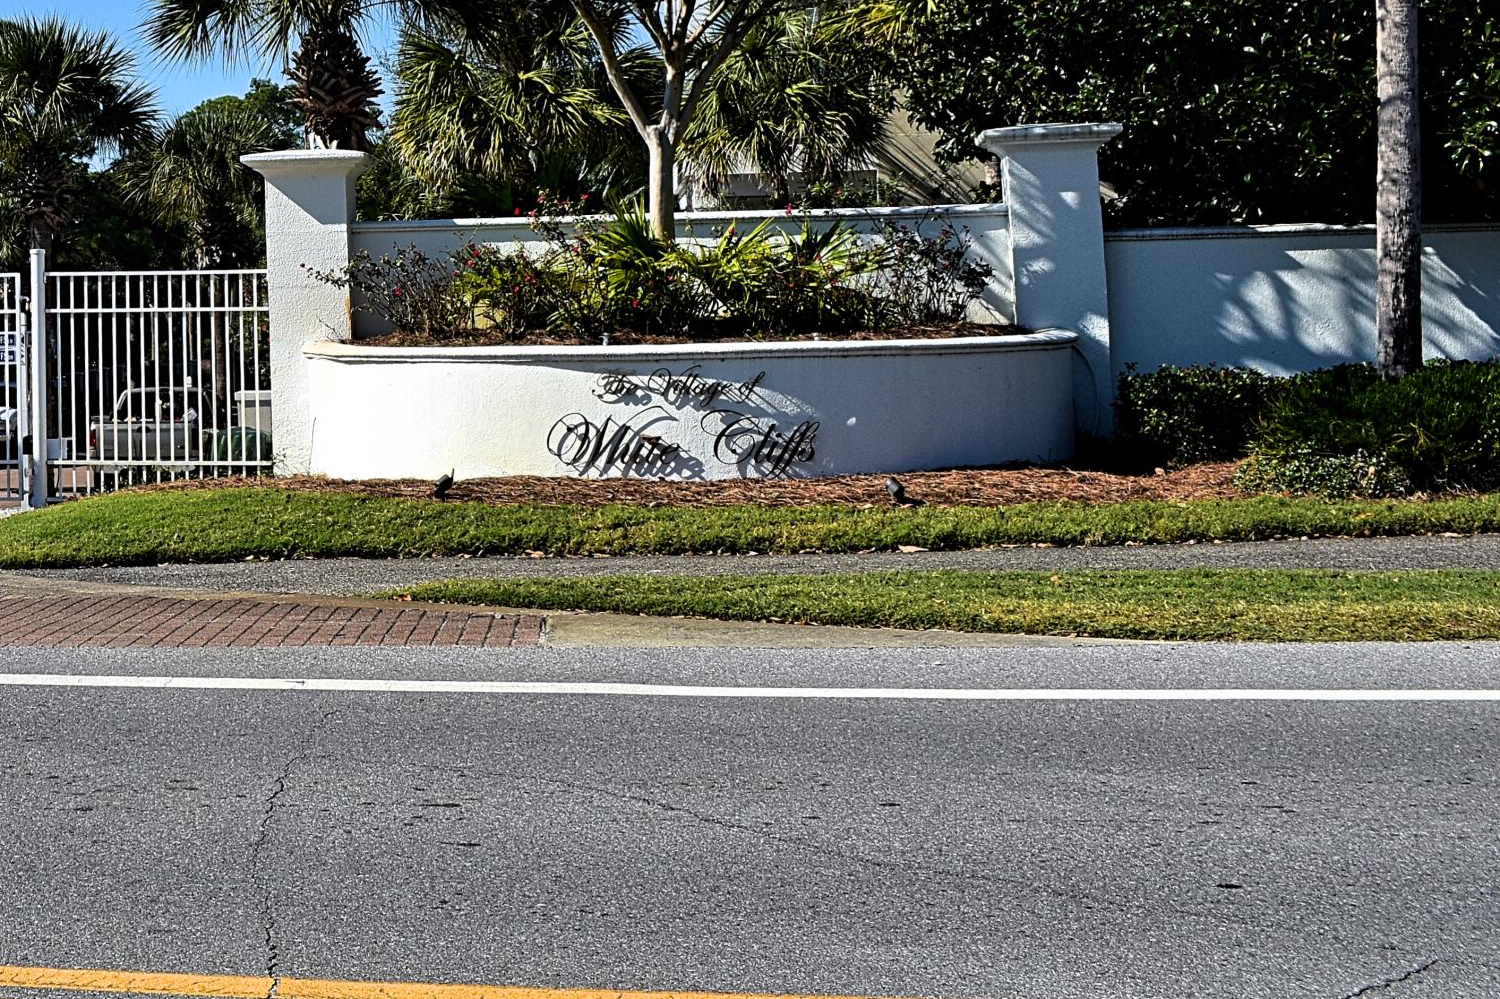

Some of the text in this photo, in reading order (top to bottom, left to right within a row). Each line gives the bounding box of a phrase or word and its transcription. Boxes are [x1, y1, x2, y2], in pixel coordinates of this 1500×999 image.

[592, 365, 766, 407] The Village of
[547, 406, 820, 479] White Cliffs
